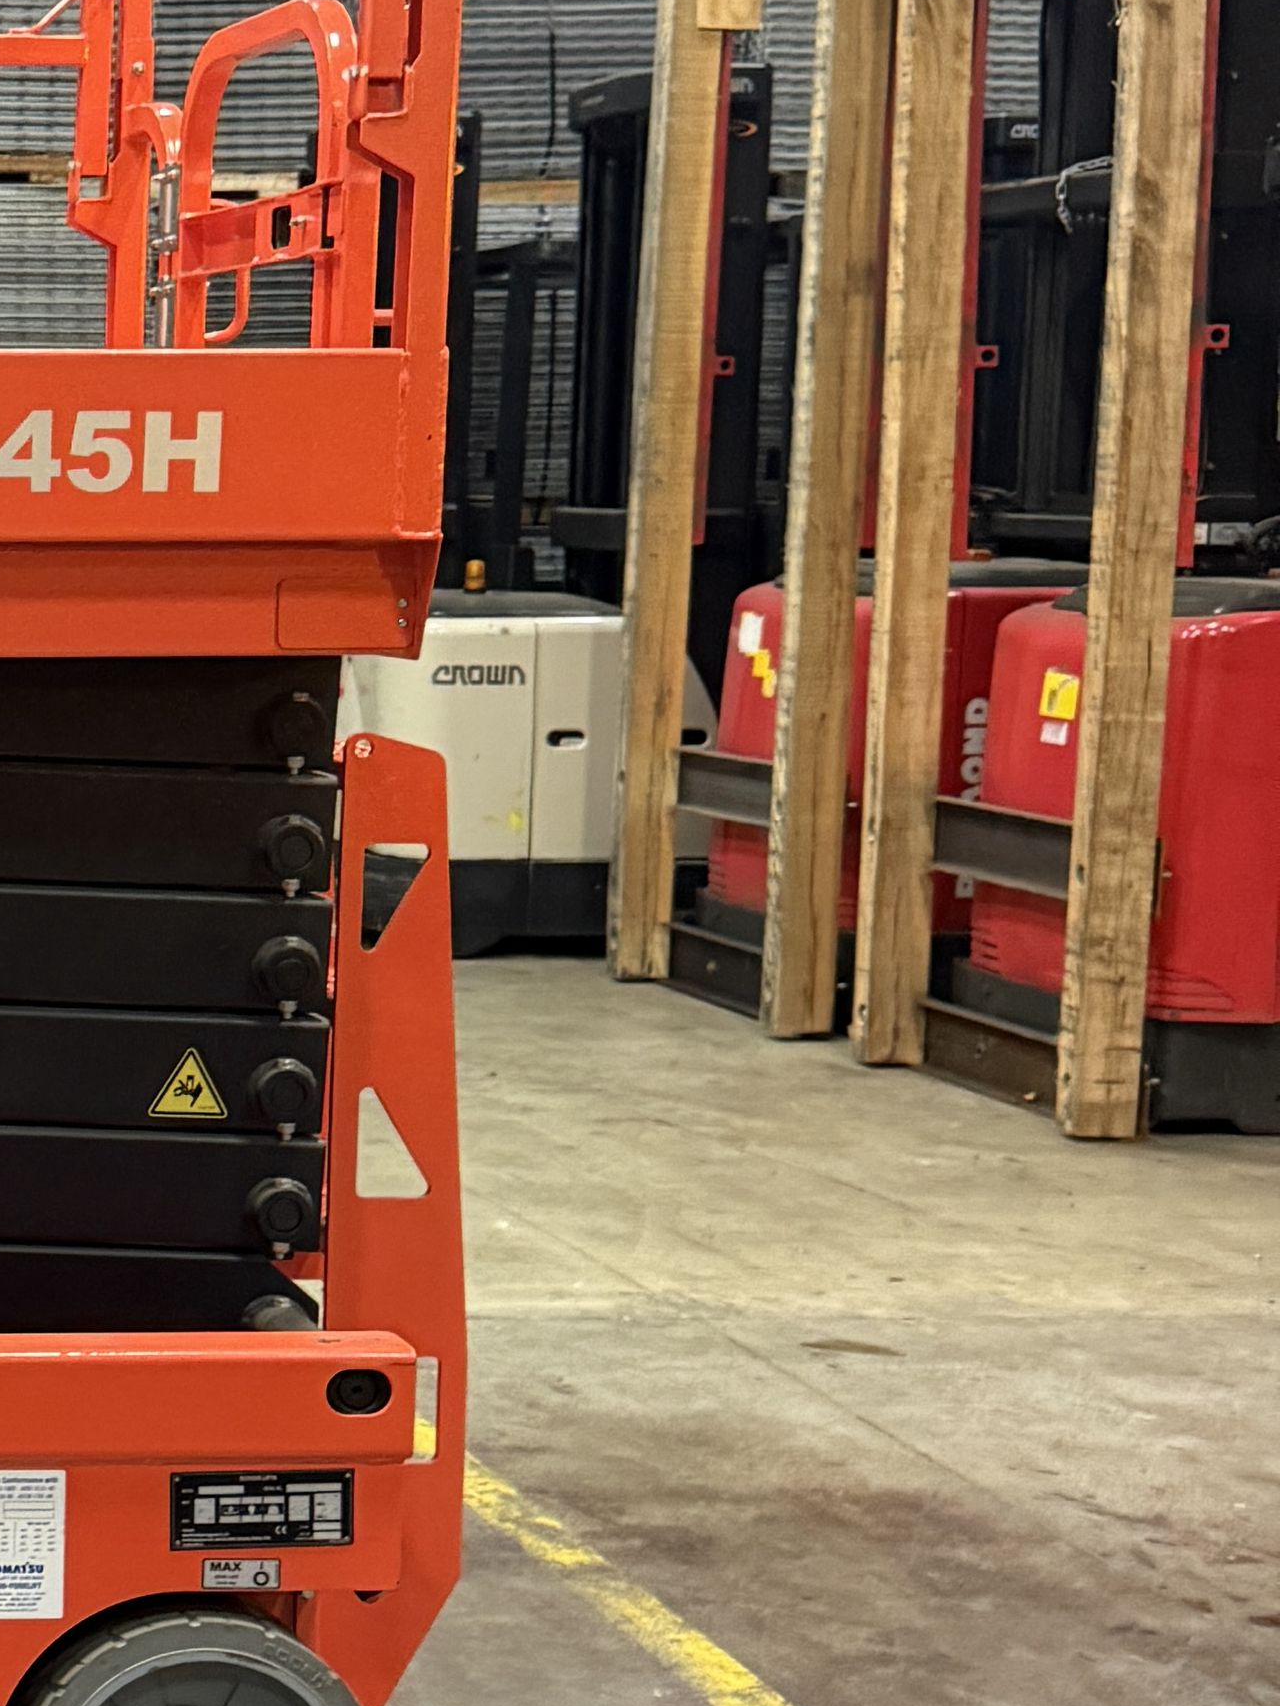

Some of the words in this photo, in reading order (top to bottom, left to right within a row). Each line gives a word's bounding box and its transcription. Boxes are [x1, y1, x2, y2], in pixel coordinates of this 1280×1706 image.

[431, 664, 526, 686] CROWN
[274, 1524, 288, 1535] CE
[209, 1561, 243, 1572] MAX
